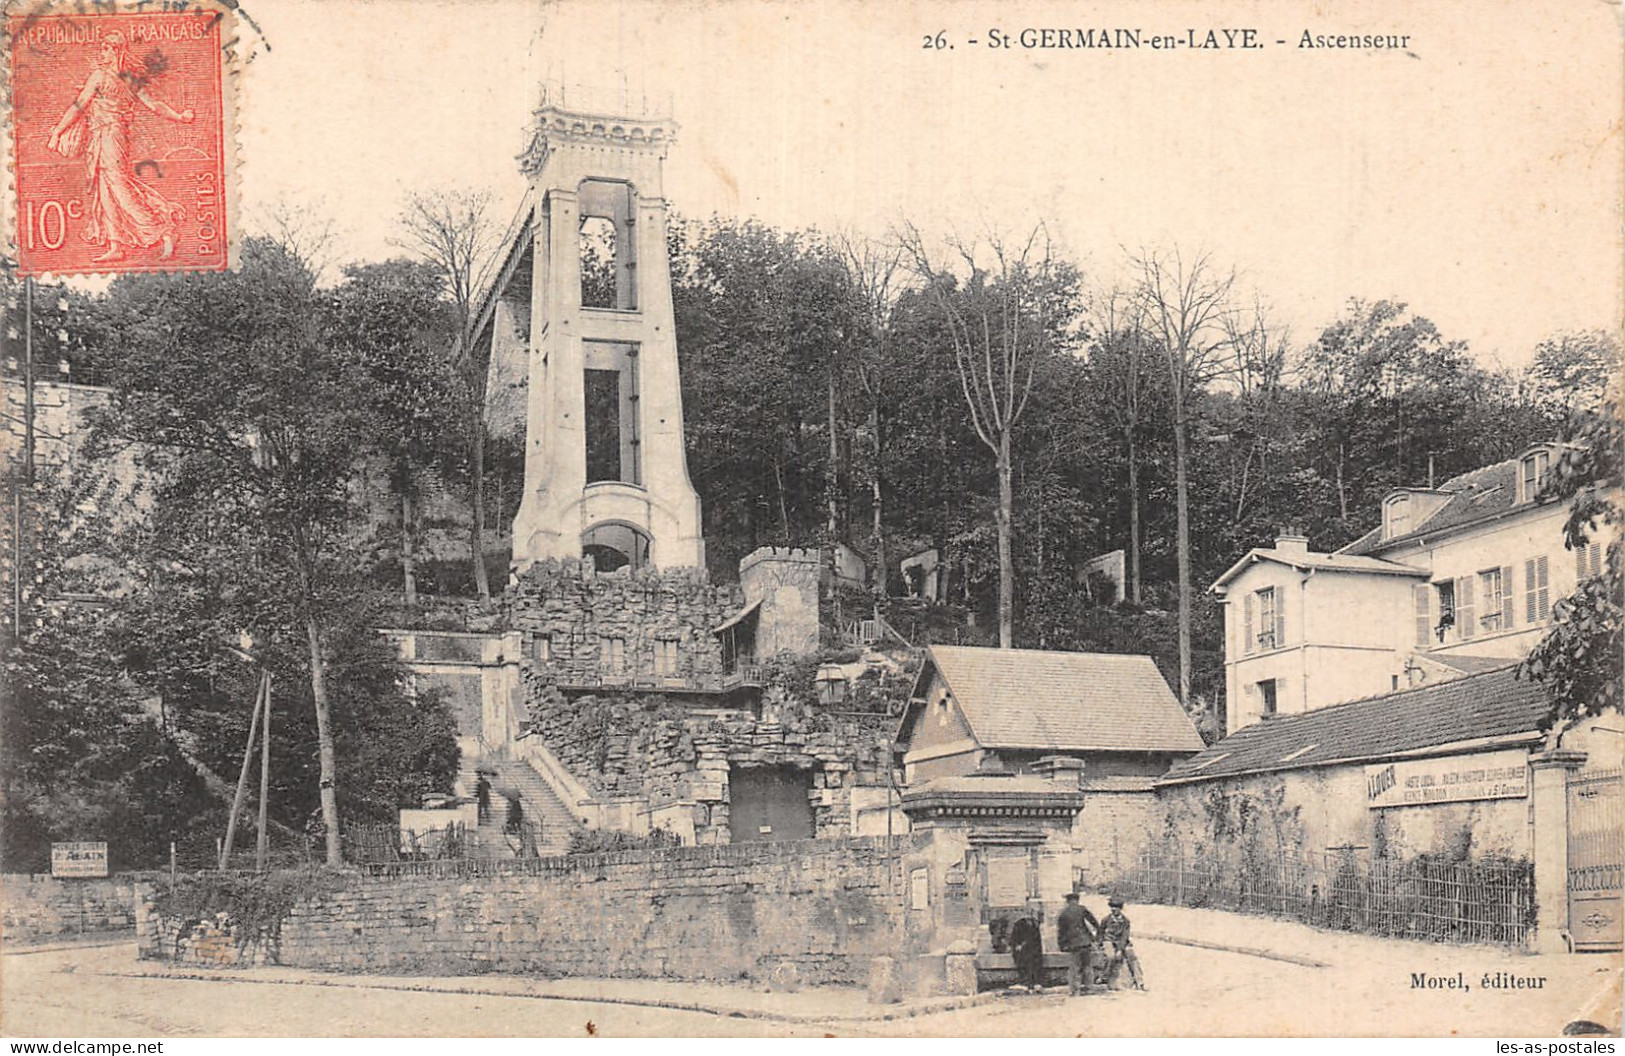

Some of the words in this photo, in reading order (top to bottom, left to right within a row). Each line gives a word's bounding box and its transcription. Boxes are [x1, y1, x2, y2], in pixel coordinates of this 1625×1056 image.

[922, 31, 954, 50] 26.
[1020, 28, 1264, 50] GERMAIN-en-LAYE.
[1298, 28, 1412, 49] Ascenseur
[196, 171, 216, 255] POSTES
[1410, 972, 1470, 993] Morel,
[1481, 972, 1548, 990] éditeur
